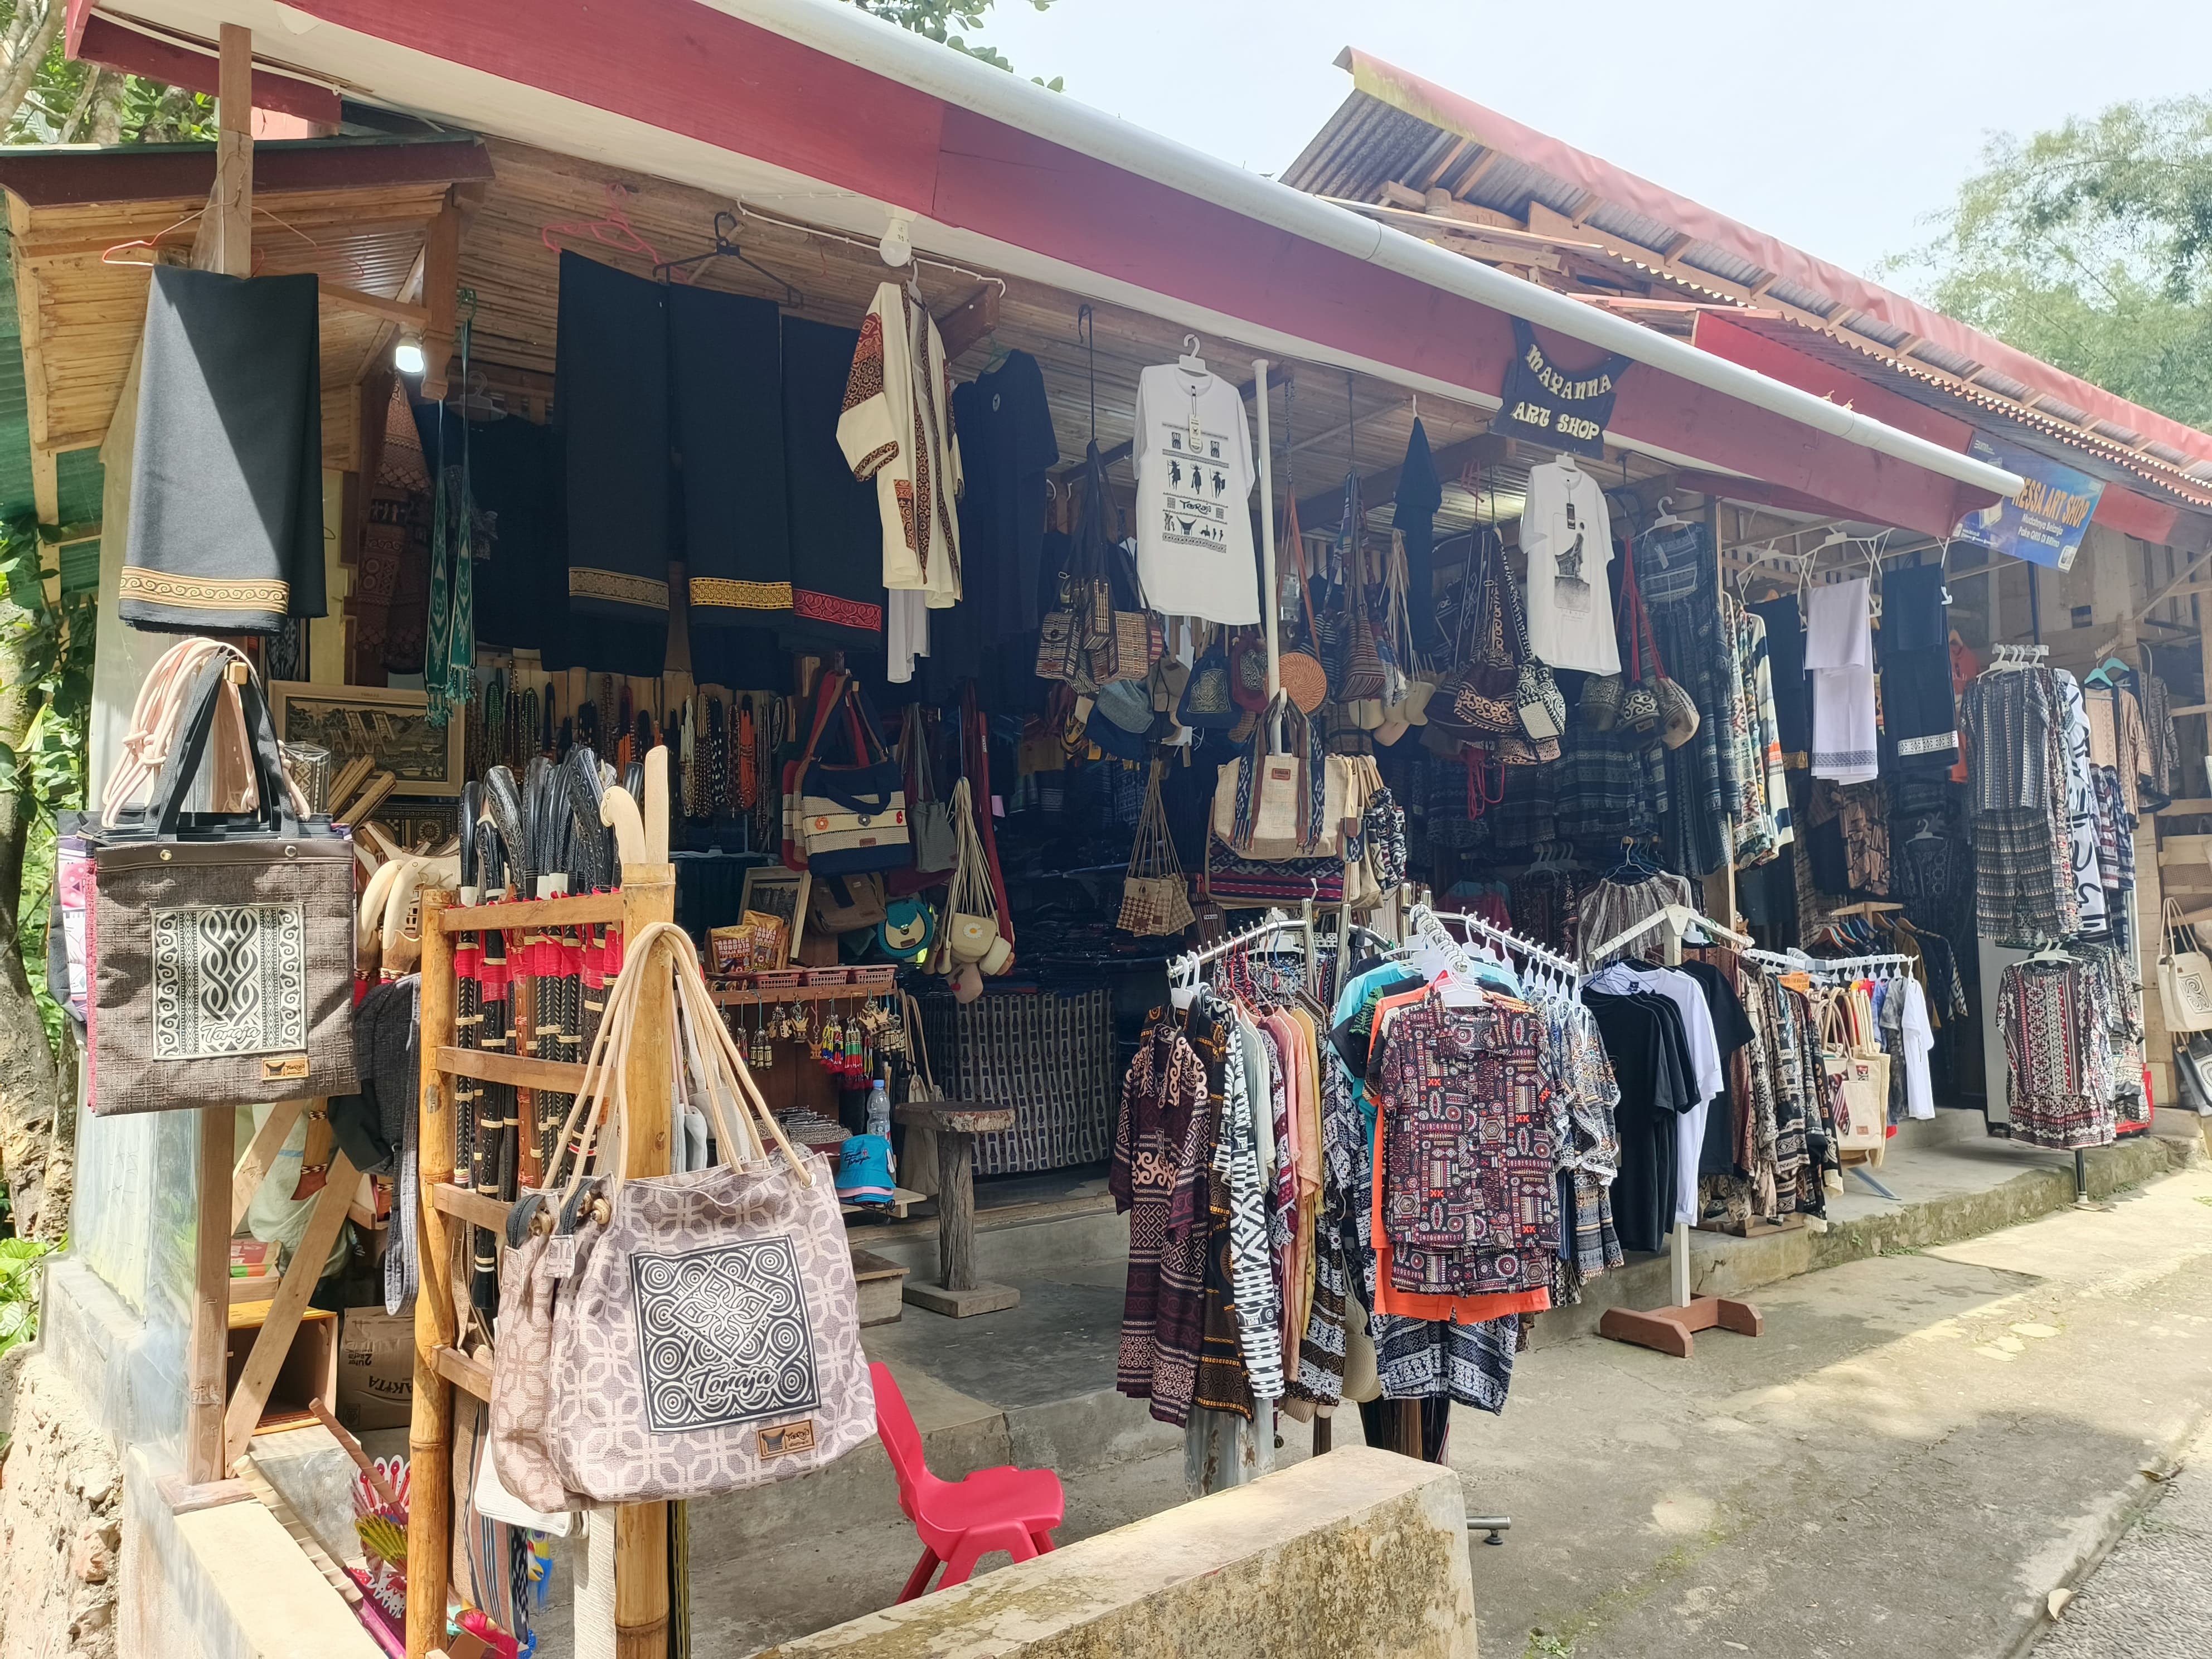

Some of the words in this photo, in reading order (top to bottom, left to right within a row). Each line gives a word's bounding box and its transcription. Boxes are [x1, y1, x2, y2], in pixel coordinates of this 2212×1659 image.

[1525, 343, 1612, 400] MAYANNA
[1511, 401, 1551, 427] ART
[1556, 414, 1600, 440] SHOP
[2043, 487, 2068, 521] ART
[2061, 495, 2091, 528] SHOP
[201, 1022, 261, 1044] Toraja
[364, 1354, 373, 1366] 2
[688, 1365, 775, 1400] Toraja
